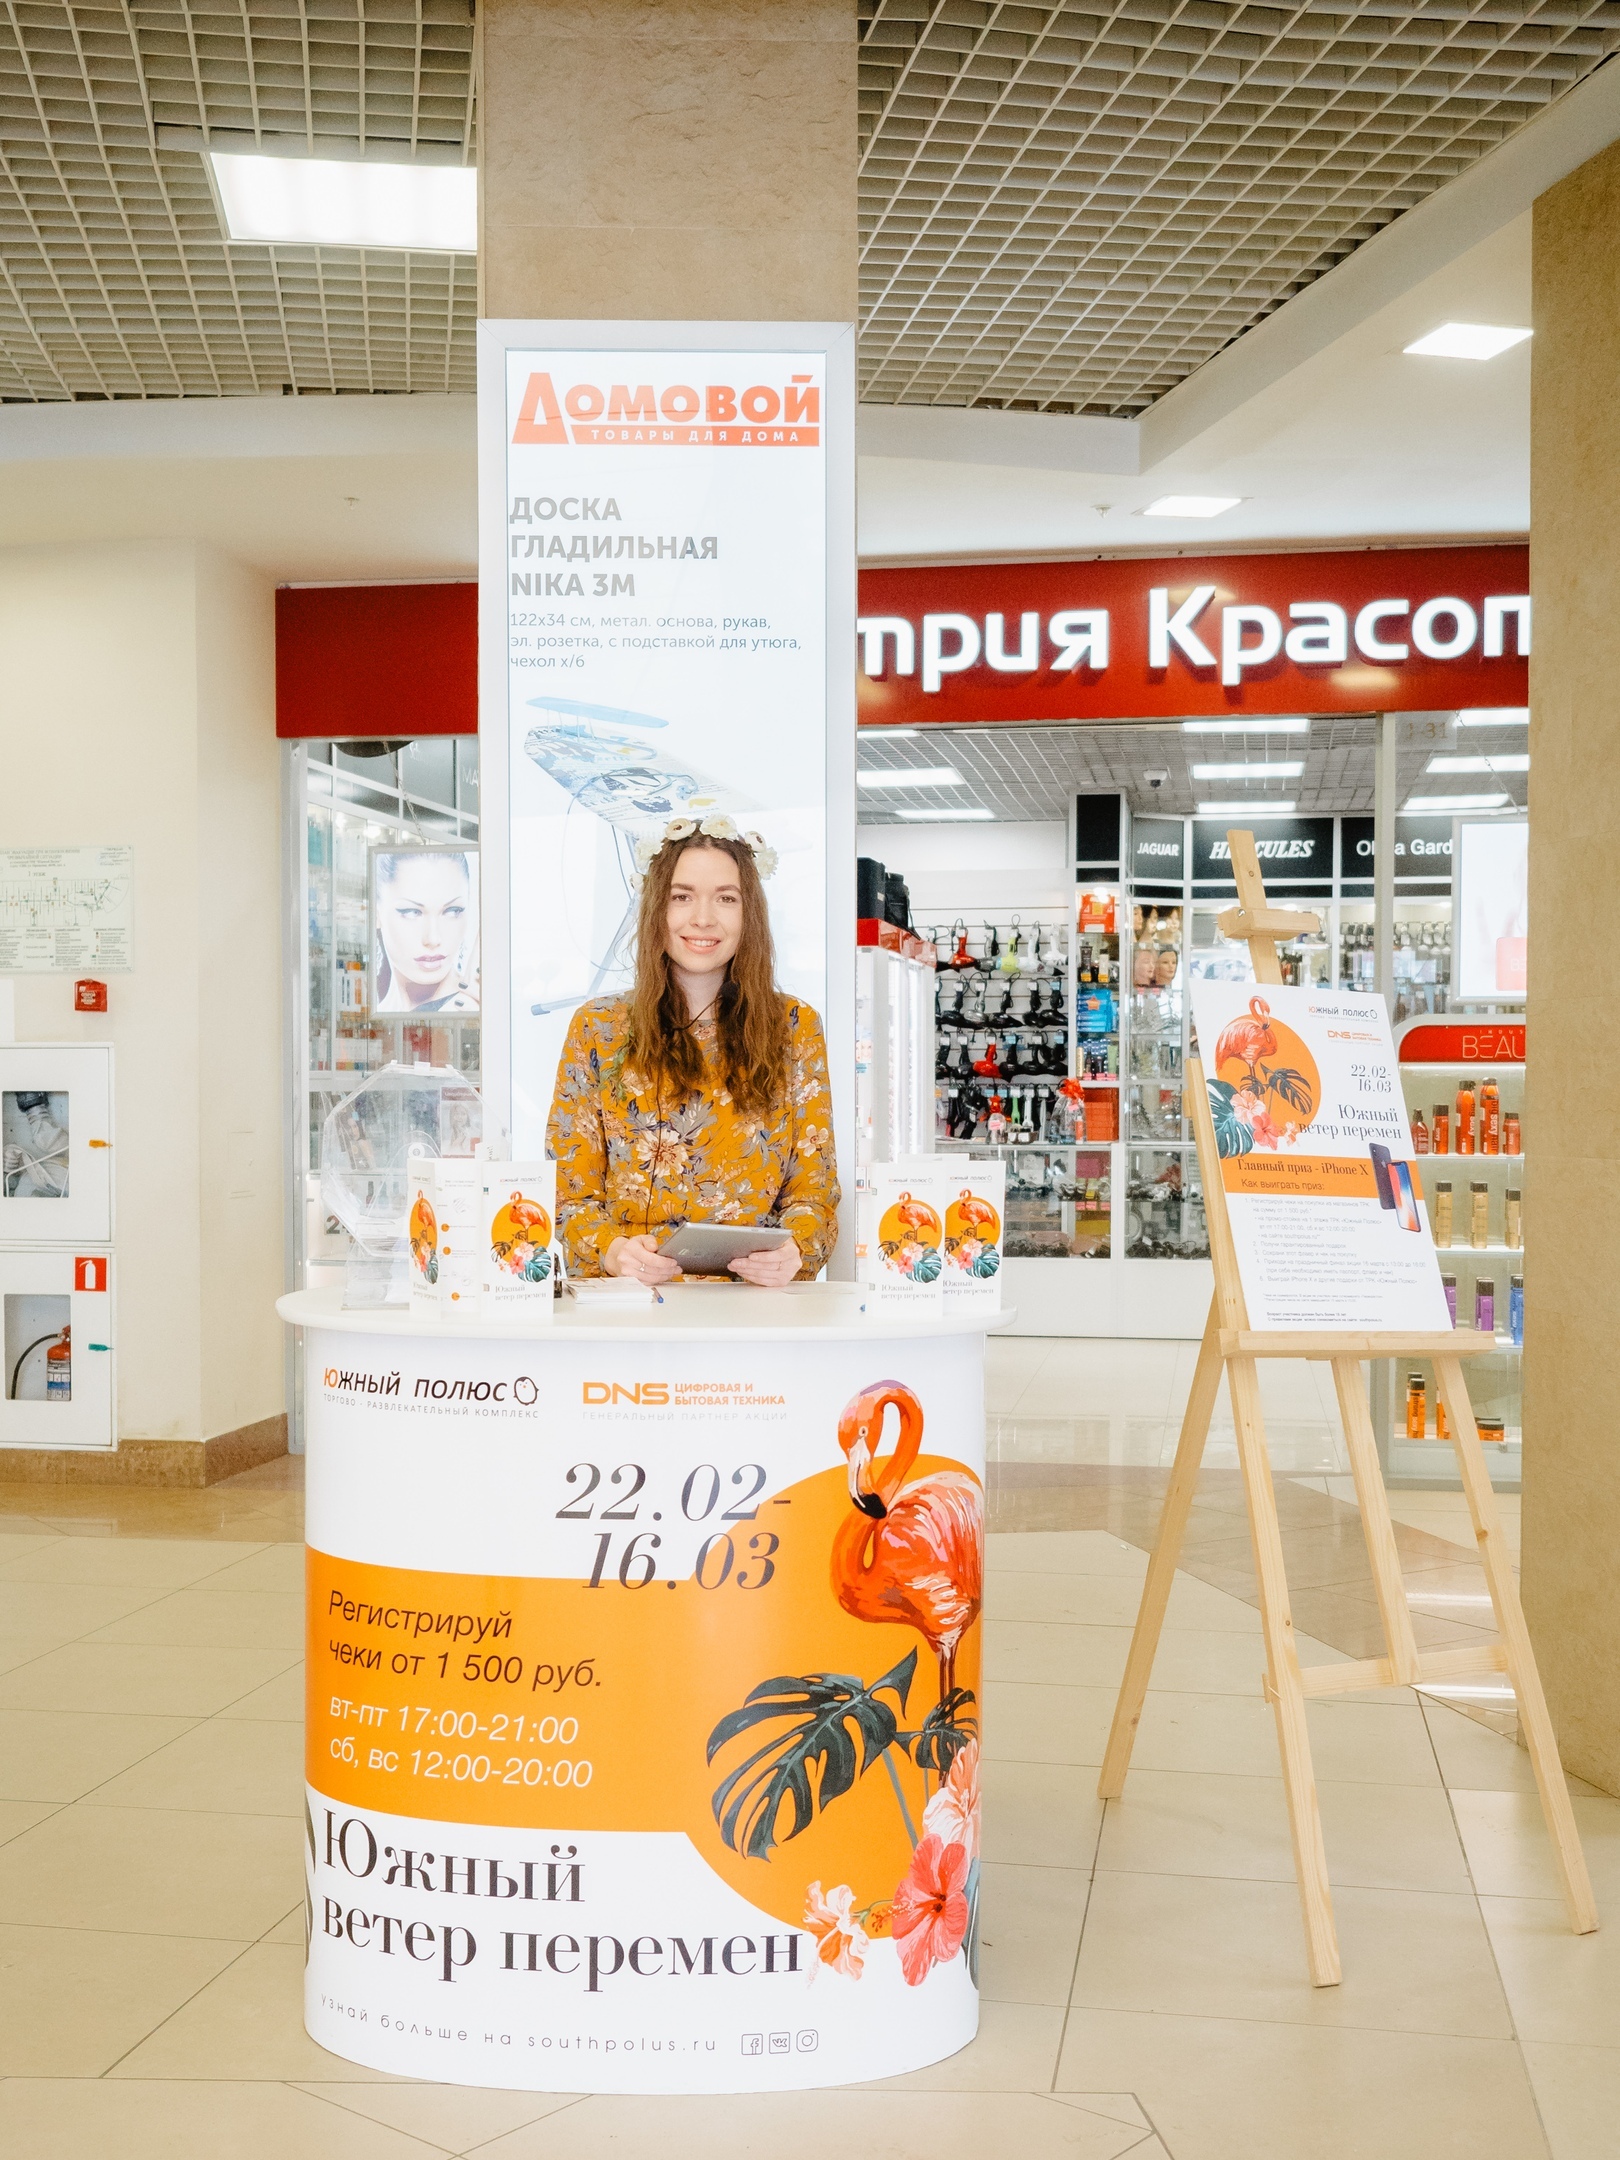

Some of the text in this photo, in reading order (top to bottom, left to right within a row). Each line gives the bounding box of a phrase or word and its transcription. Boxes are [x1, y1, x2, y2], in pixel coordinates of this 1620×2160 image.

[591, 429, 798, 443] ТОВАРЫ ДЛЯ ДОМА
[509, 497, 622, 524] ДОСКА
[510, 535, 718, 562] ГЛАДИЛЬНАЯ
[511, 573, 635, 596] NIKA 3M
[570, 616, 596, 629] см,
[600, 616, 650, 628] метал.
[656, 617, 718, 629] основа,
[722, 617, 771, 630] рукав,
[510, 635, 801, 651] эл. розетка, с подставкой для утюга,
[510, 655, 556, 668] чехол
[1137, 842, 1180, 857] JAGUAR
[1209, 839, 1316, 860] HCULES
[1308, 1006, 1369, 1018] ЮЖНЫЙ ПОЛЮС
[1327, 1030, 1351, 1040] DNS
[1351, 1064, 1391, 1078] 22.02-
[1359, 1079, 1391, 1093] 16.03
[1338, 1104, 1398, 1122] Южный
[1299, 1123, 1339, 1140] ветер
[1342, 1125, 1402, 1141] перемен
[1237, 1158, 1285, 1172] Главный
[1287, 1164, 1312, 1176] приз
[1322, 1162, 1357, 1176] iPhone
[1359, 1164, 1369, 1176] X
[1241, 1179, 1325, 1192] Как выиграть приз:
[324, 1367, 508, 1402] ЮЖНЫЙ ПОЛЮС
[582, 1382, 670, 1405] DNS
[674, 1383, 753, 1394] ЦИФРОВАЯ И
[324, 1393, 539, 1419] ТОРГОВО РАЗВЛЕКАТЕЛЬНЫЙ КОМПЛЕКС
[674, 1395, 785, 1405] БЫТОВАЯ ТЕХНИКА
[582, 1411, 788, 1422] ГЕНЕРАЛЬНЫЙ ПАРТНЕР АКЦИИ
[555, 1462, 791, 1522] 22.02-
[582, 1532, 780, 1590] 16.03
[329, 1590, 512, 1644] Регистрируй
[329, 1639, 601, 1693] чеки от 1 500 руб.
[330, 1696, 579, 1744] вт-пт 17:00-21:00
[330, 1736, 594, 1788] сб, вс 12:00-20:00
[323, 1808, 586, 1902] Южный
[322, 1895, 803, 1993] ветер перемен
[321, 1993, 716, 2053] узнай больше на southpolus.ru
